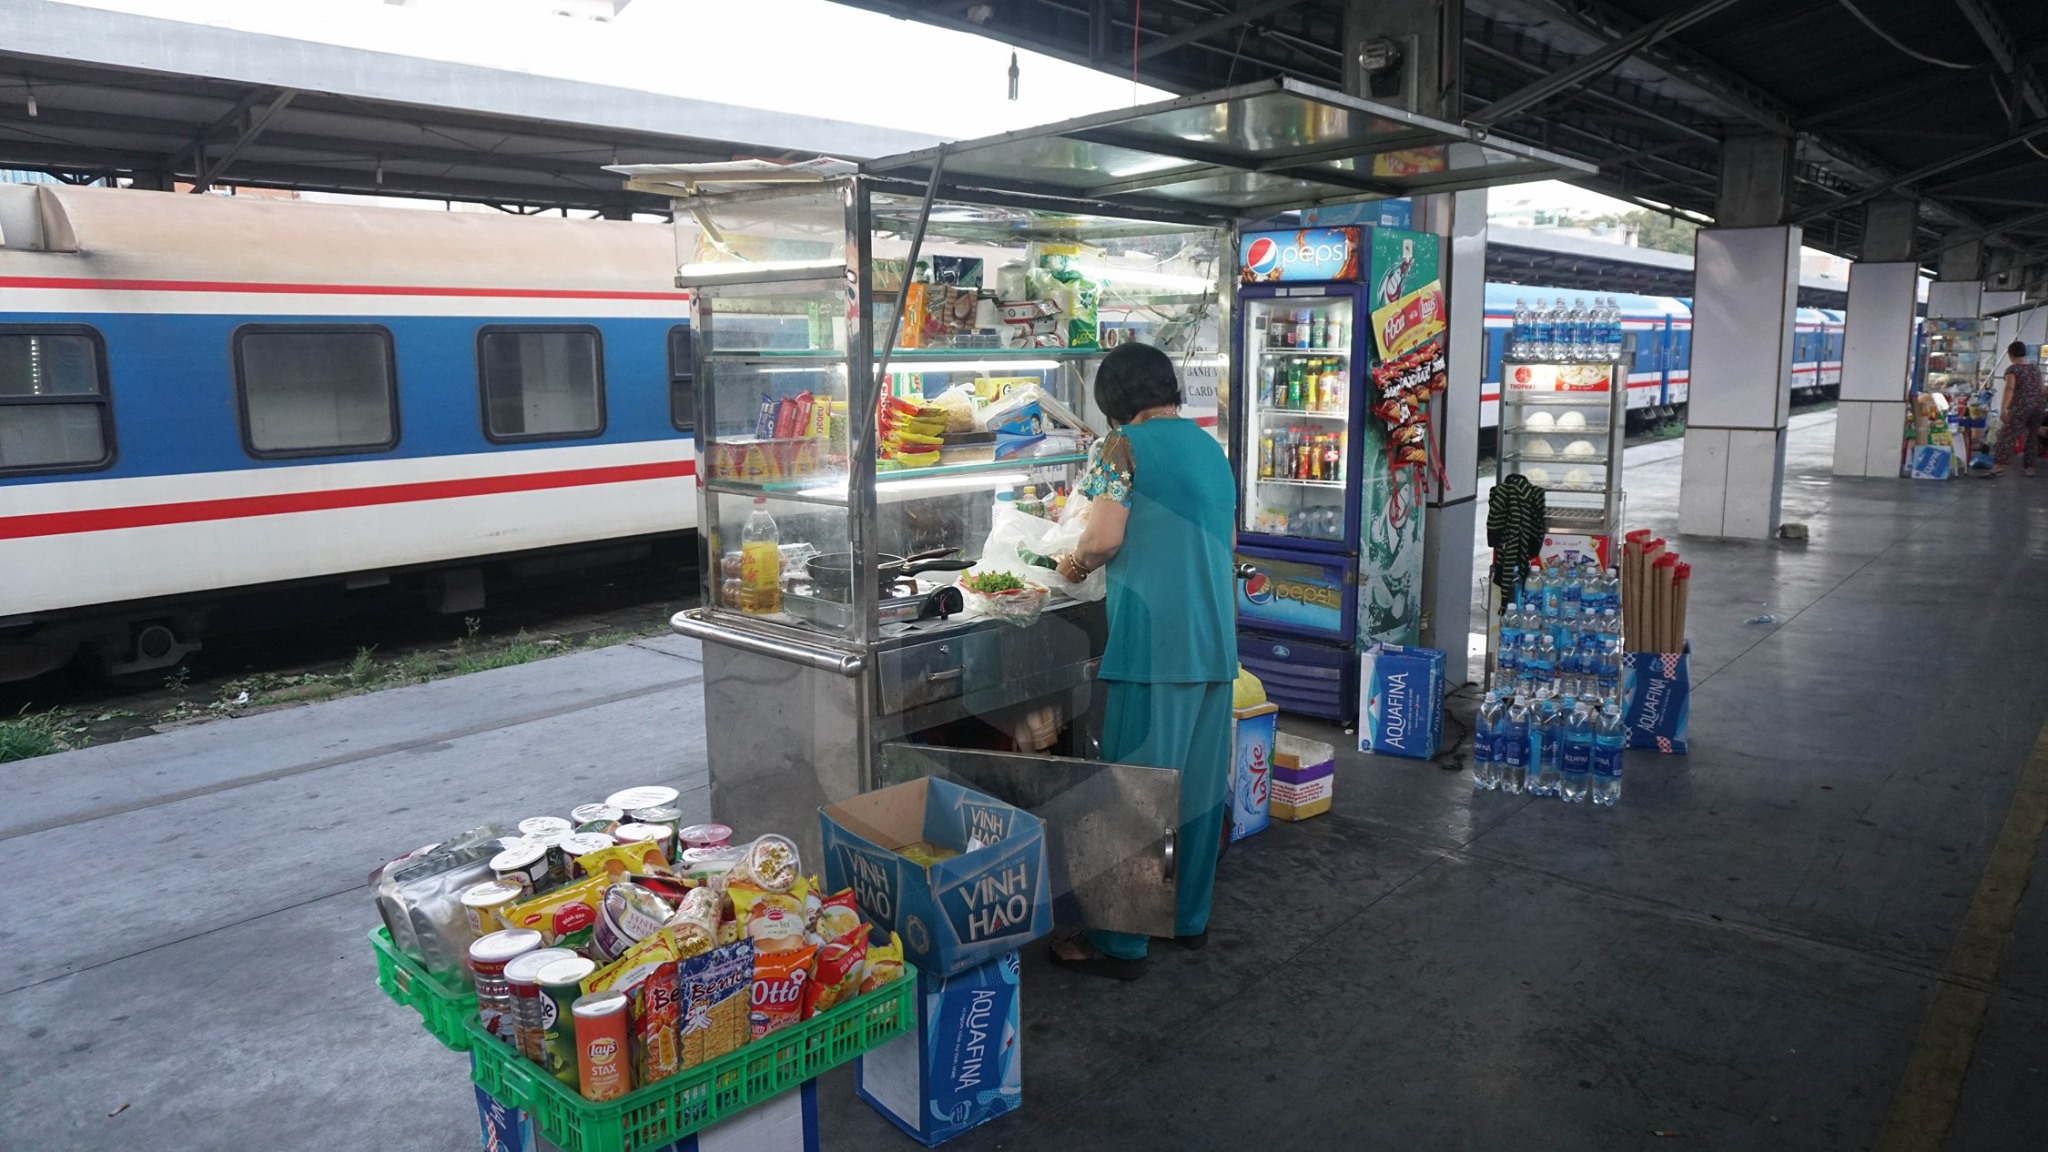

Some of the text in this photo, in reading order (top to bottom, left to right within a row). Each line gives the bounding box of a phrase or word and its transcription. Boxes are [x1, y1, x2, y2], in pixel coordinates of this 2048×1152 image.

[1282, 242, 1349, 267] pepsi
[1188, 385, 1213, 397] CARD
[1275, 584, 1332, 606] pepsi
[1385, 671, 1409, 749] AQUAFINA
[1637, 678, 1669, 733] AQUAFINA
[691, 970, 743, 1002] Bento
[751, 980, 801, 1005] Otto
[955, 990, 996, 1093] AQUAFINA
[591, 1063, 617, 1076] STAX
